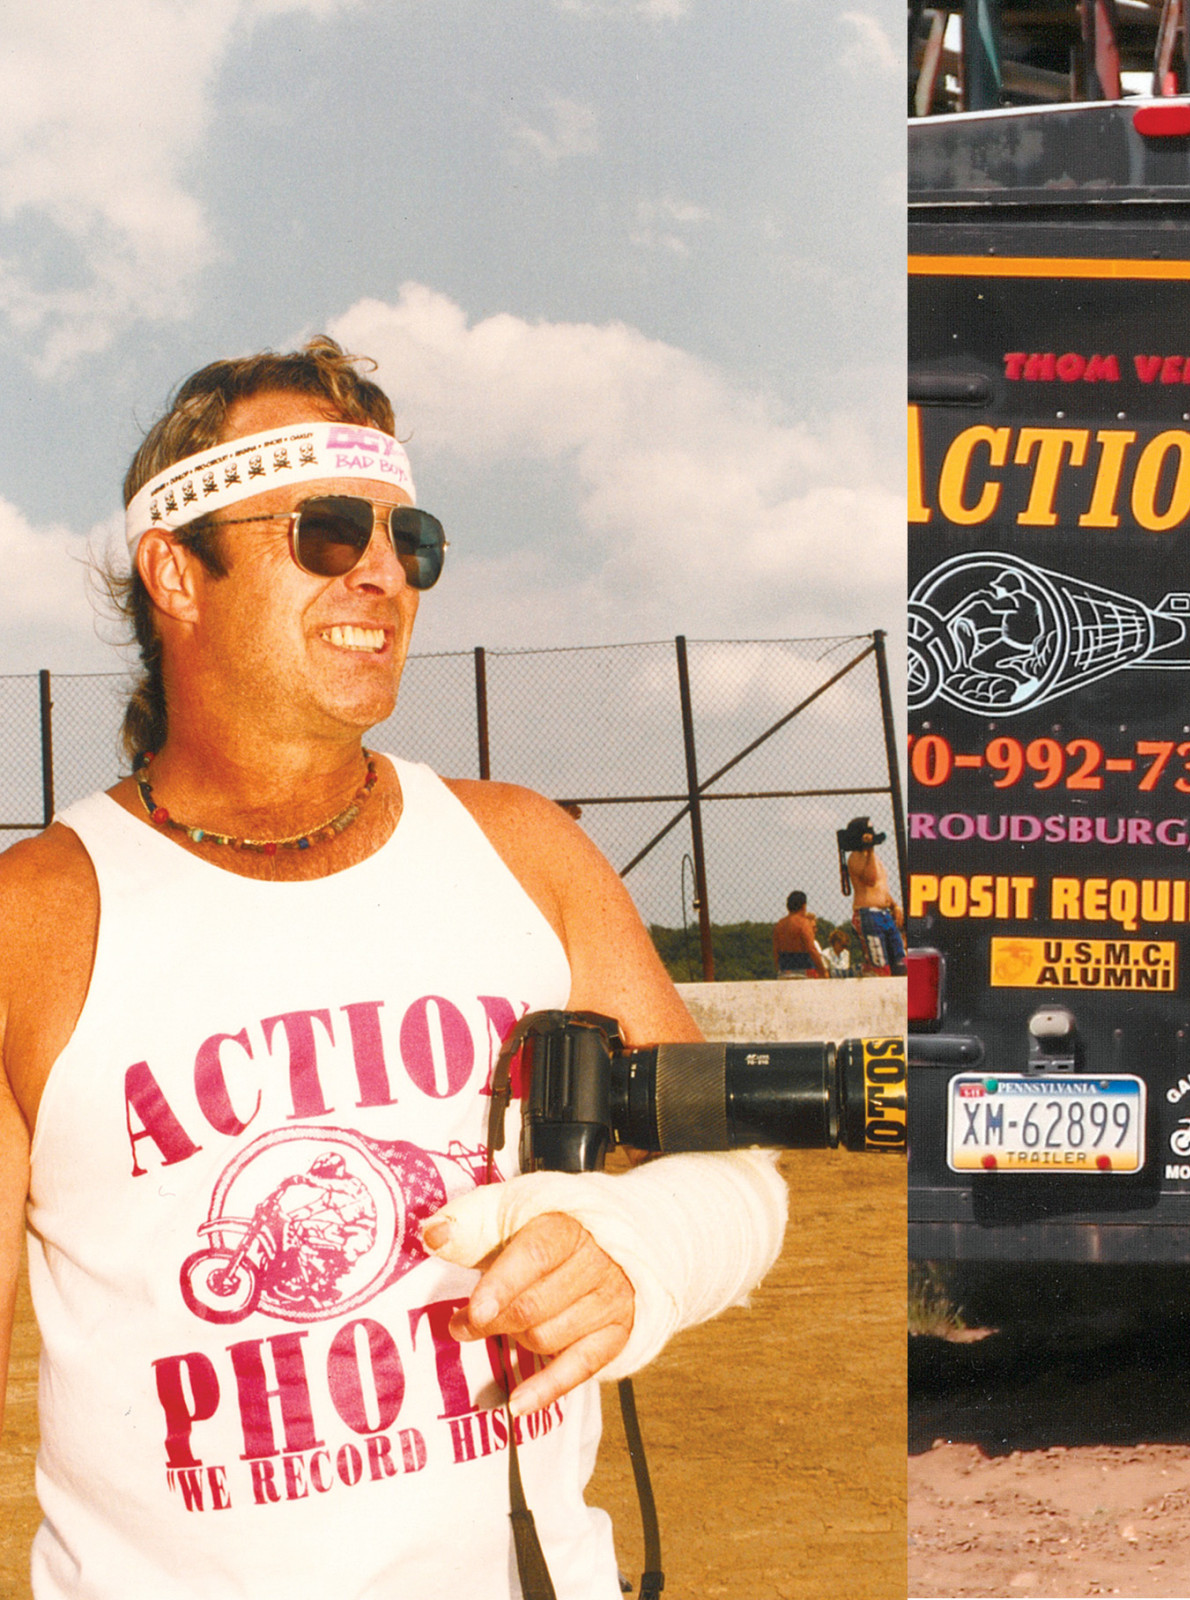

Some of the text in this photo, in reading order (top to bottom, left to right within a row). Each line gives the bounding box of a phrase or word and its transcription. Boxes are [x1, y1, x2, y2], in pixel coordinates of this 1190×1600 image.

[1003, 352, 1119, 382] THOM
[336, 454, 375, 469] BAD
[1043, 941, 1170, 968] U.S.M.C.
[1036, 966, 1171, 989] ALUMNI
[998, 1082, 1098, 1094] PENNSYLVANIA
[962, 1101, 1131, 1148] XM-62899
[1007, 1151, 1088, 1164] TRAILER
[250, 1427, 428, 1506] RECORD
